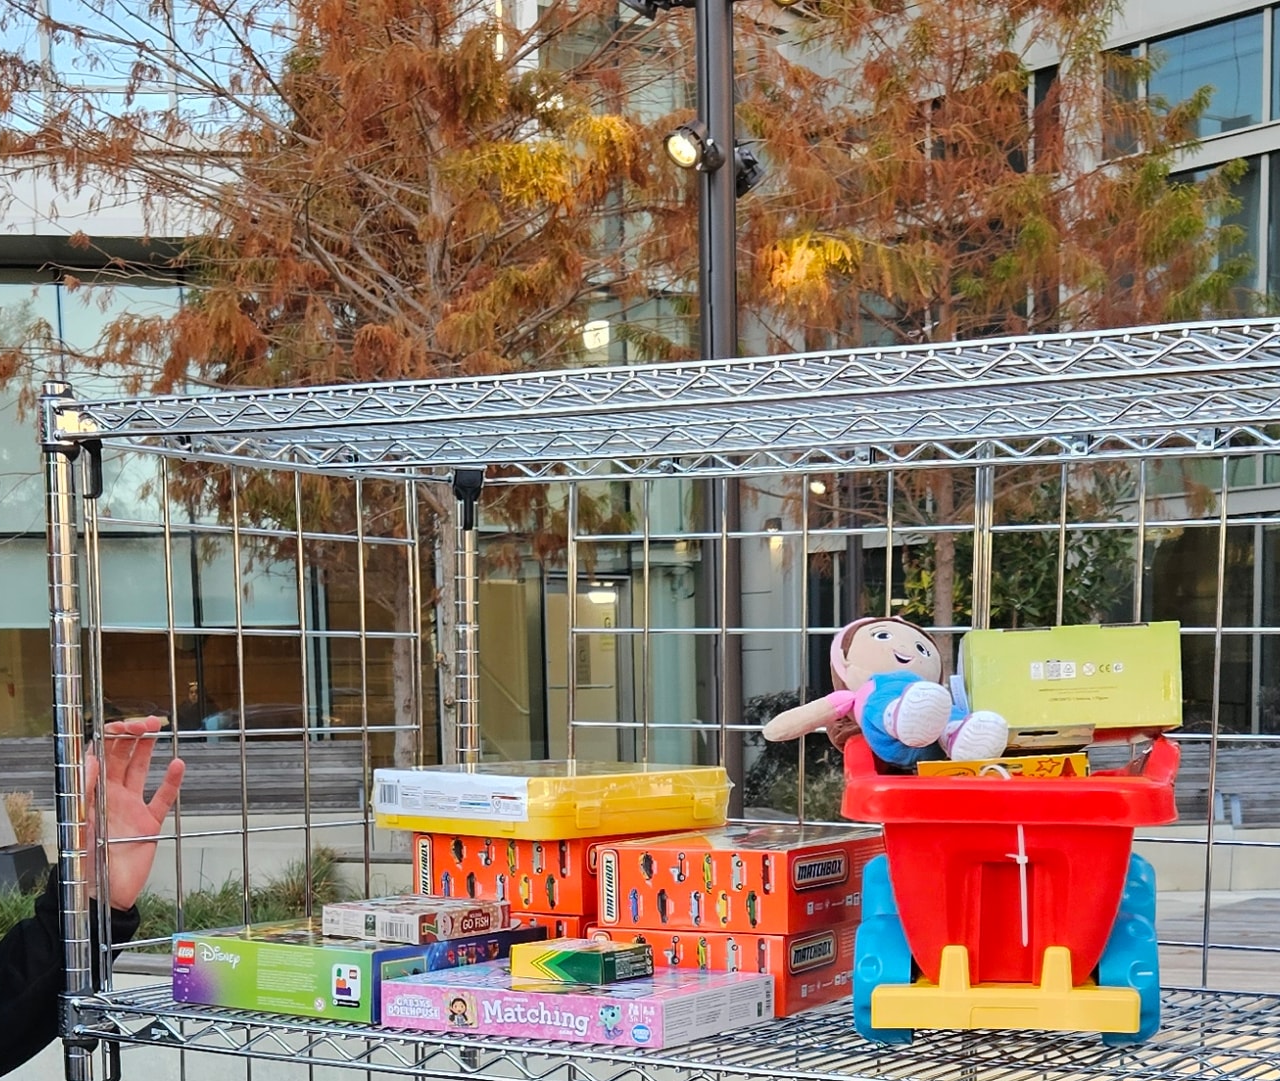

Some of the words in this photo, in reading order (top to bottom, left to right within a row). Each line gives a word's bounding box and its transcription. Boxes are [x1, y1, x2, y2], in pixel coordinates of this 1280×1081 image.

[797, 859, 842, 880] MATCHBOX
[605, 858, 614, 918] MATCHBOX
[462, 918, 473, 930] GO
[475, 915, 489, 928] FISH
[793, 940, 832, 964] MATCHBOX
[482, 999, 590, 1036] Matching
